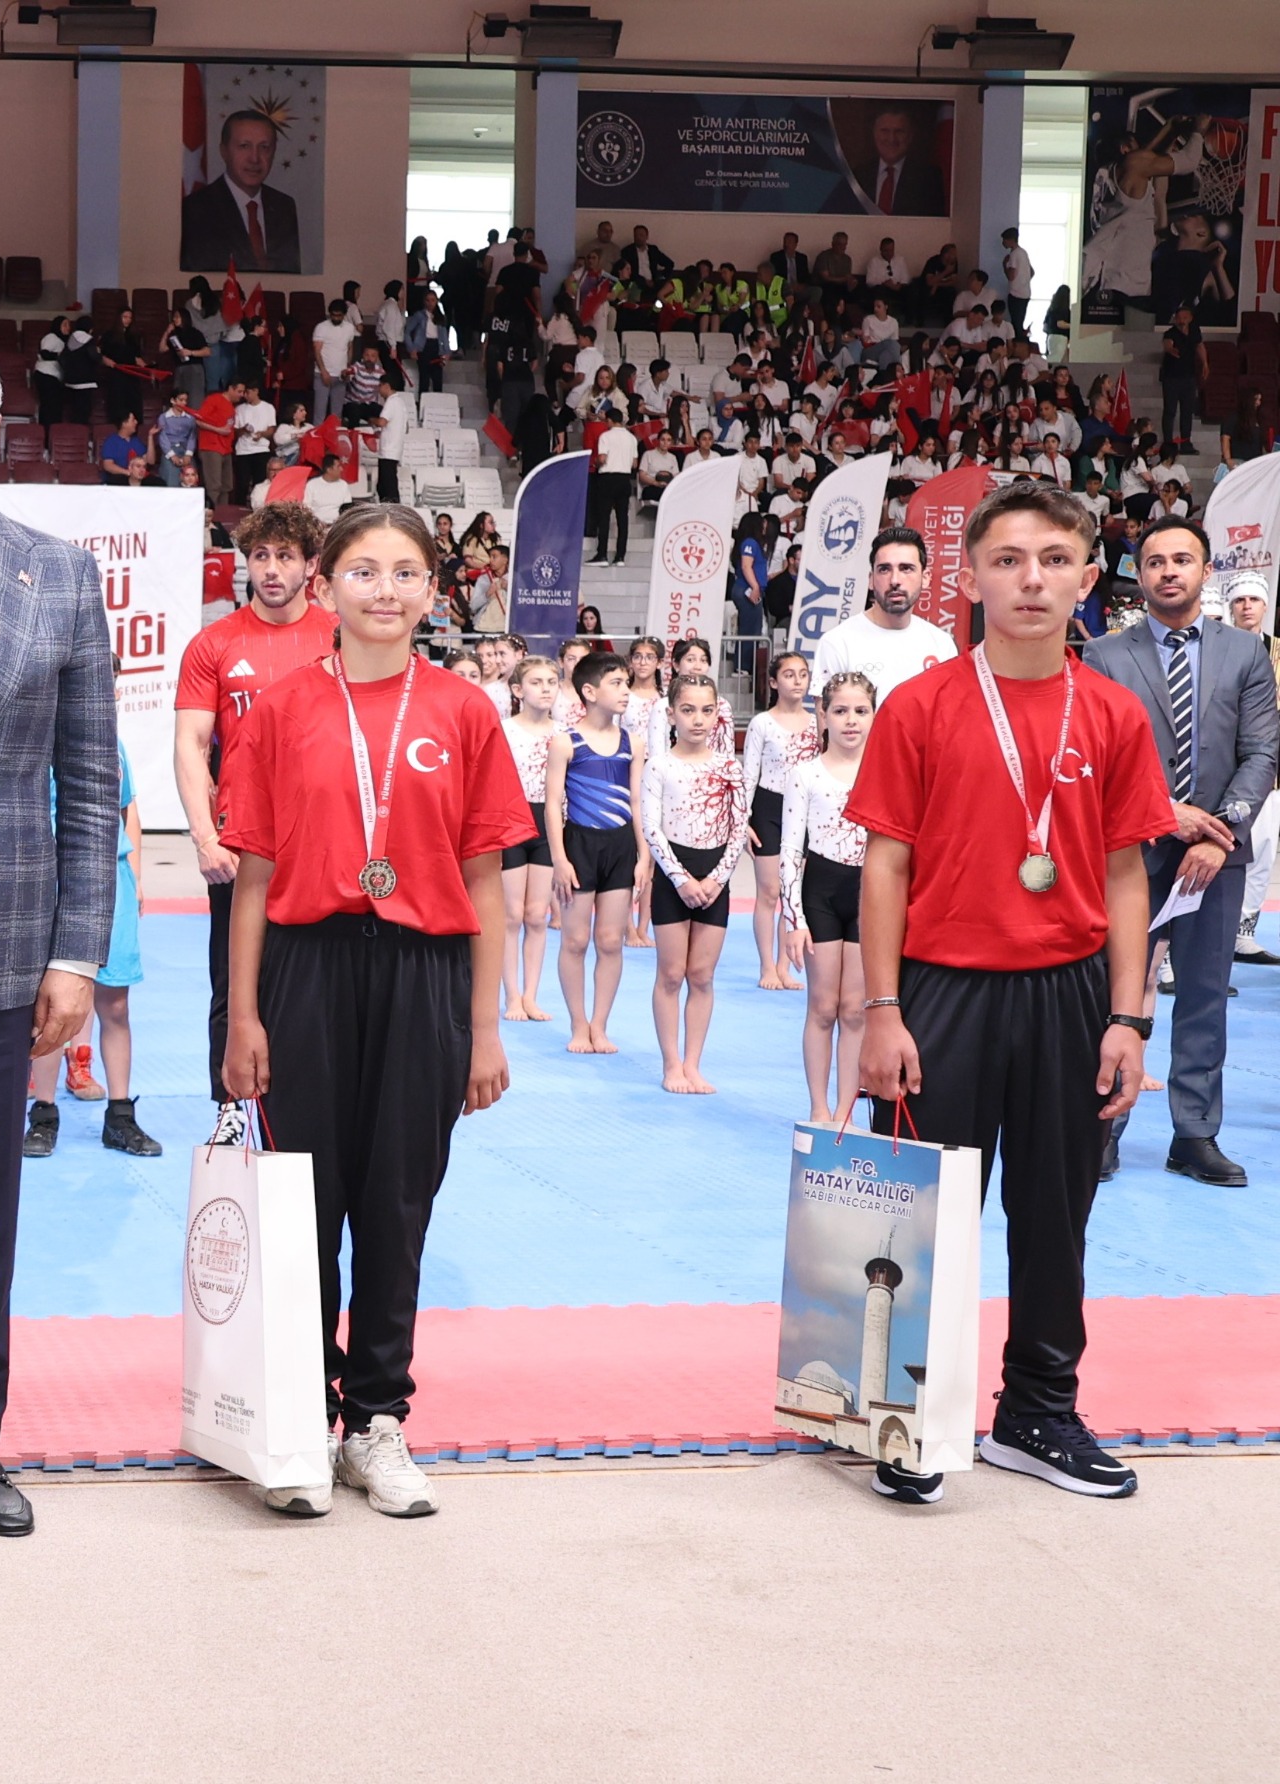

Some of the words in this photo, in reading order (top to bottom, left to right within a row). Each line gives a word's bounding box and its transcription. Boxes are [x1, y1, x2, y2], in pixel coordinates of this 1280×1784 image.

[693, 115, 721, 129] TÜM
[726, 117, 796, 131] ANTRENÖR
[678, 130, 693, 140] VE
[697, 130, 810, 144] SPORCULARIMIZA
[682, 144, 742, 156] BAŞARILAR
[745, 144, 805, 156] DİLİYORUM
[706, 170, 716, 178] Dr.
[740, 180, 760, 188] SPOR
[940, 506, 965, 602] VALİLİĞİ
[518, 597, 535, 605] SPOR
[537, 598, 572, 606] BAKANLIĞI
[532, 589, 562, 598] GENÇLİK
[563, 590, 572, 598] VE
[667, 592, 683, 634] SPOR
[687, 593, 701, 621] T.C.
[404, 682, 411, 690] VE
[125, 699, 163, 712] OLSUN!
[396, 691, 410, 721] GENÇLİK
[1061, 686, 1075, 717] GENÇLİK
[385, 721, 402, 768] CUMHURİYETİ
[380, 770, 394, 800] TÜRKİYE
[851, 1159, 877, 1177] T.C.
[805, 1170, 852, 1191] HATAY
[856, 1180, 914, 1204] VALİLİĞİ
[839, 1195, 880, 1212] NECCAR
[199, 1280, 215, 1291] HATAY
